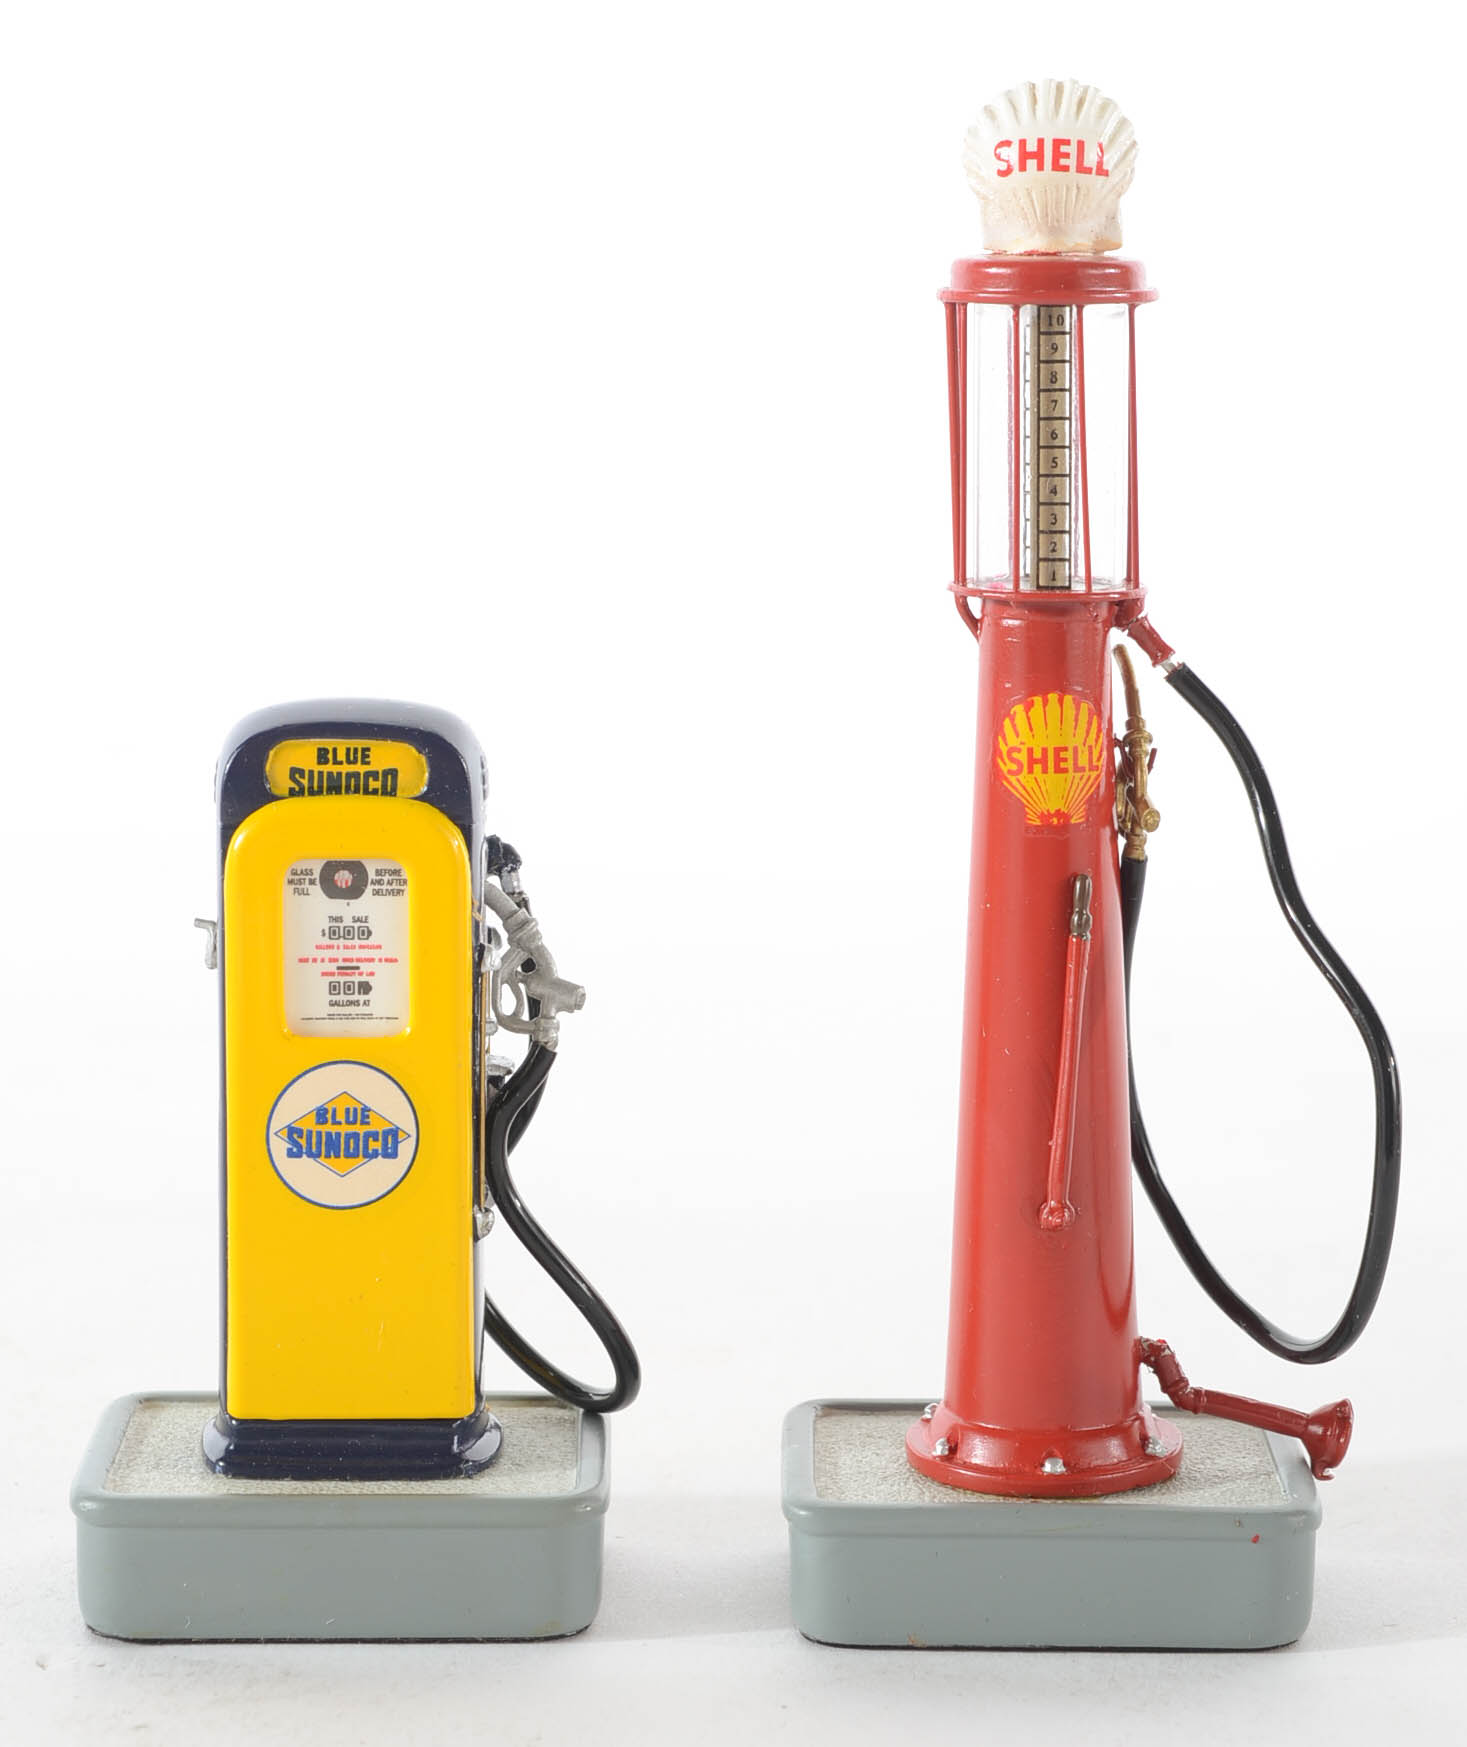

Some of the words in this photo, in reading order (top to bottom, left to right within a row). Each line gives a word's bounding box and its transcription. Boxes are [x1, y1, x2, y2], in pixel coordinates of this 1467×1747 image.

[993, 137, 1110, 178] SHELL
[1047, 314, 1065, 327] 10
[1051, 342, 1058, 355] 9
[1050, 370, 1058, 384] 8
[1051, 399, 1058, 412] 7
[1050, 428, 1058, 440] 6
[1051, 456, 1059, 469] 5
[1049, 484, 1058, 497] 4
[1050, 513, 1058, 526] 3
[1050, 541, 1058, 553] 2
[1052, 568, 1057, 581] 1
[316, 747, 371, 765] BLUE
[1006, 745, 1099, 776] SHELL
[288, 767, 399, 797] SUNOCO
[290, 868, 314, 876] GLASS
[374, 868, 402, 877] BEFORE
[287, 878, 306, 886] MUST
[308, 878, 318, 886] BE
[386, 879, 408, 887] AFTER
[293, 887, 310, 896] FULL
[372, 888, 405, 897] DELIVERY
[328, 915, 344, 923] THIS
[351, 915, 369, 923] SALE
[328, 999, 361, 1007] GALLONS
[362, 999, 370, 1007] AT
[315, 1106, 371, 1125] BLUE
[286, 1126, 399, 1159] SUNOCO
